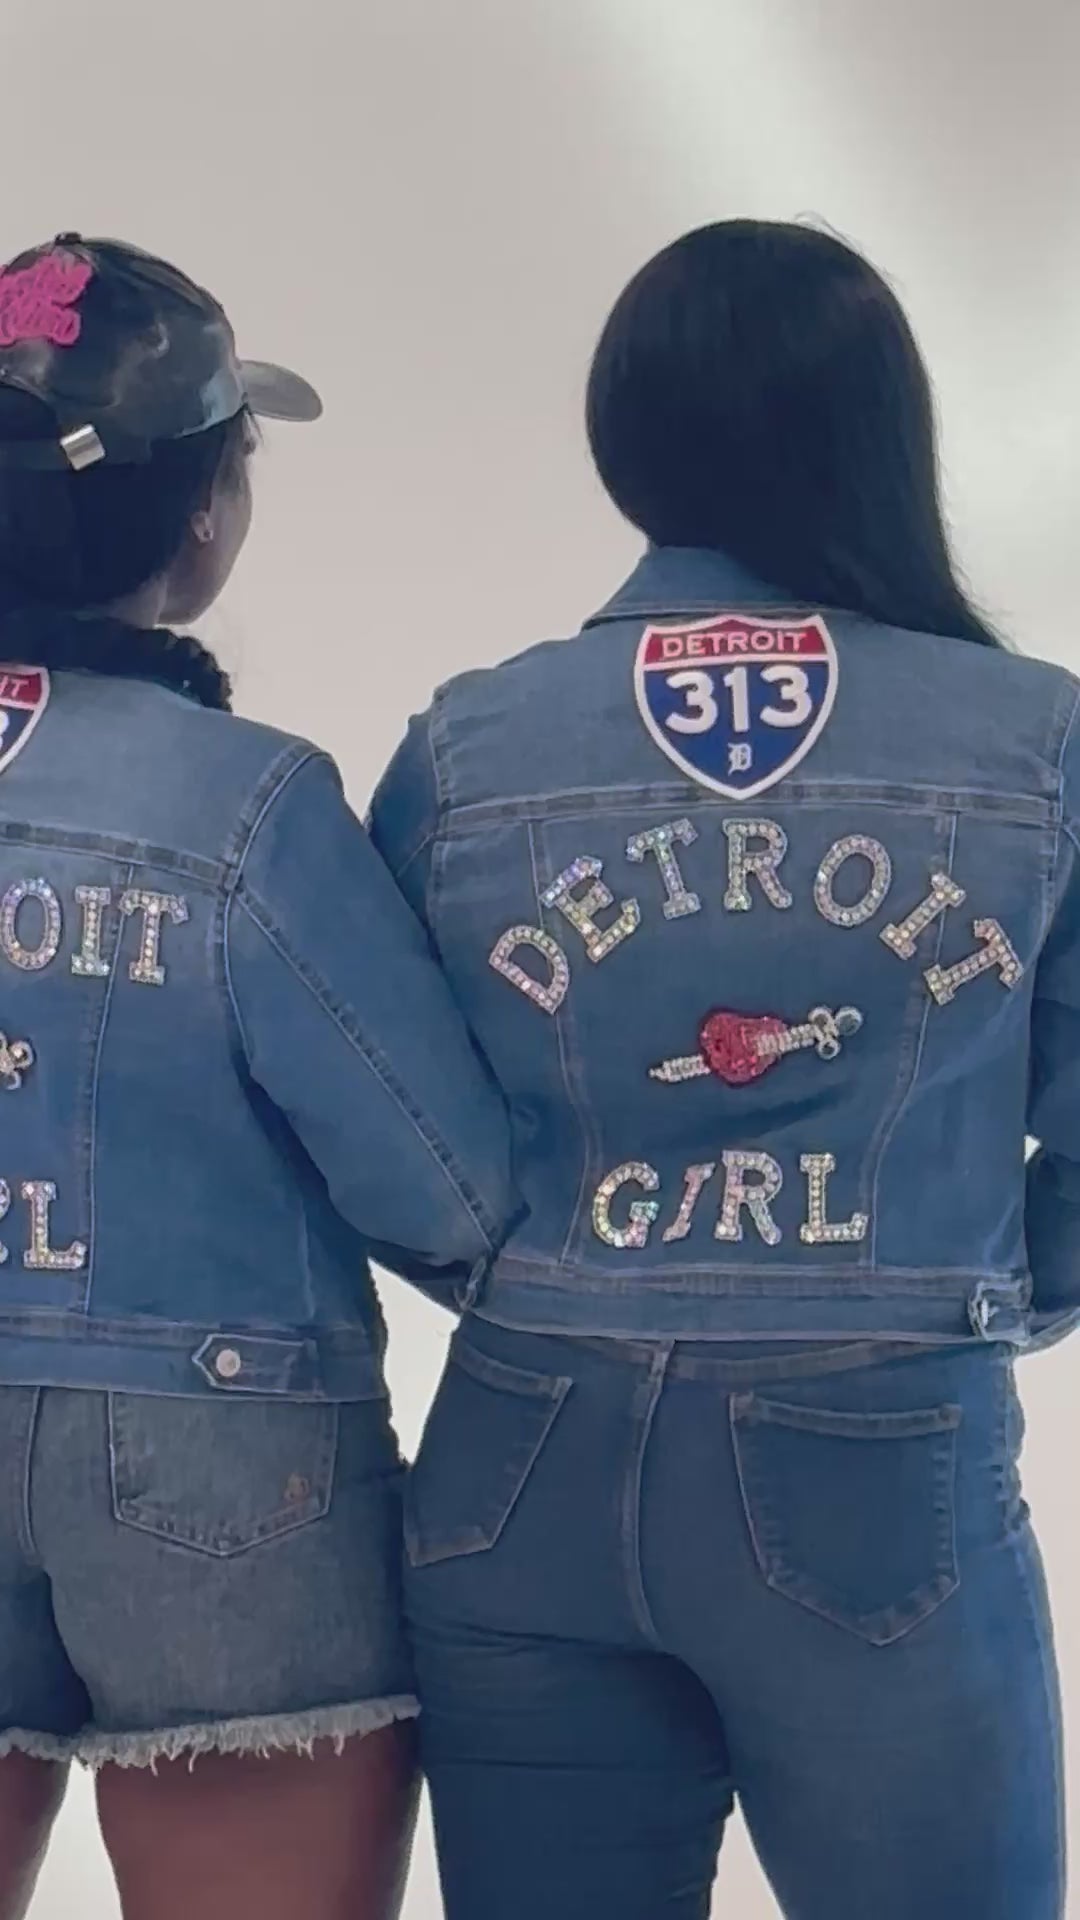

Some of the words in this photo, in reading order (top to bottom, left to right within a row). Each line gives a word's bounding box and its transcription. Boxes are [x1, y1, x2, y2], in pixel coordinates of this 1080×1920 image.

[662, 630, 807, 658] DETROIT
[665, 664, 812, 734] 313
[489, 818, 1023, 1014] DETROIT
[592, 1150, 869, 1248] GIRL
